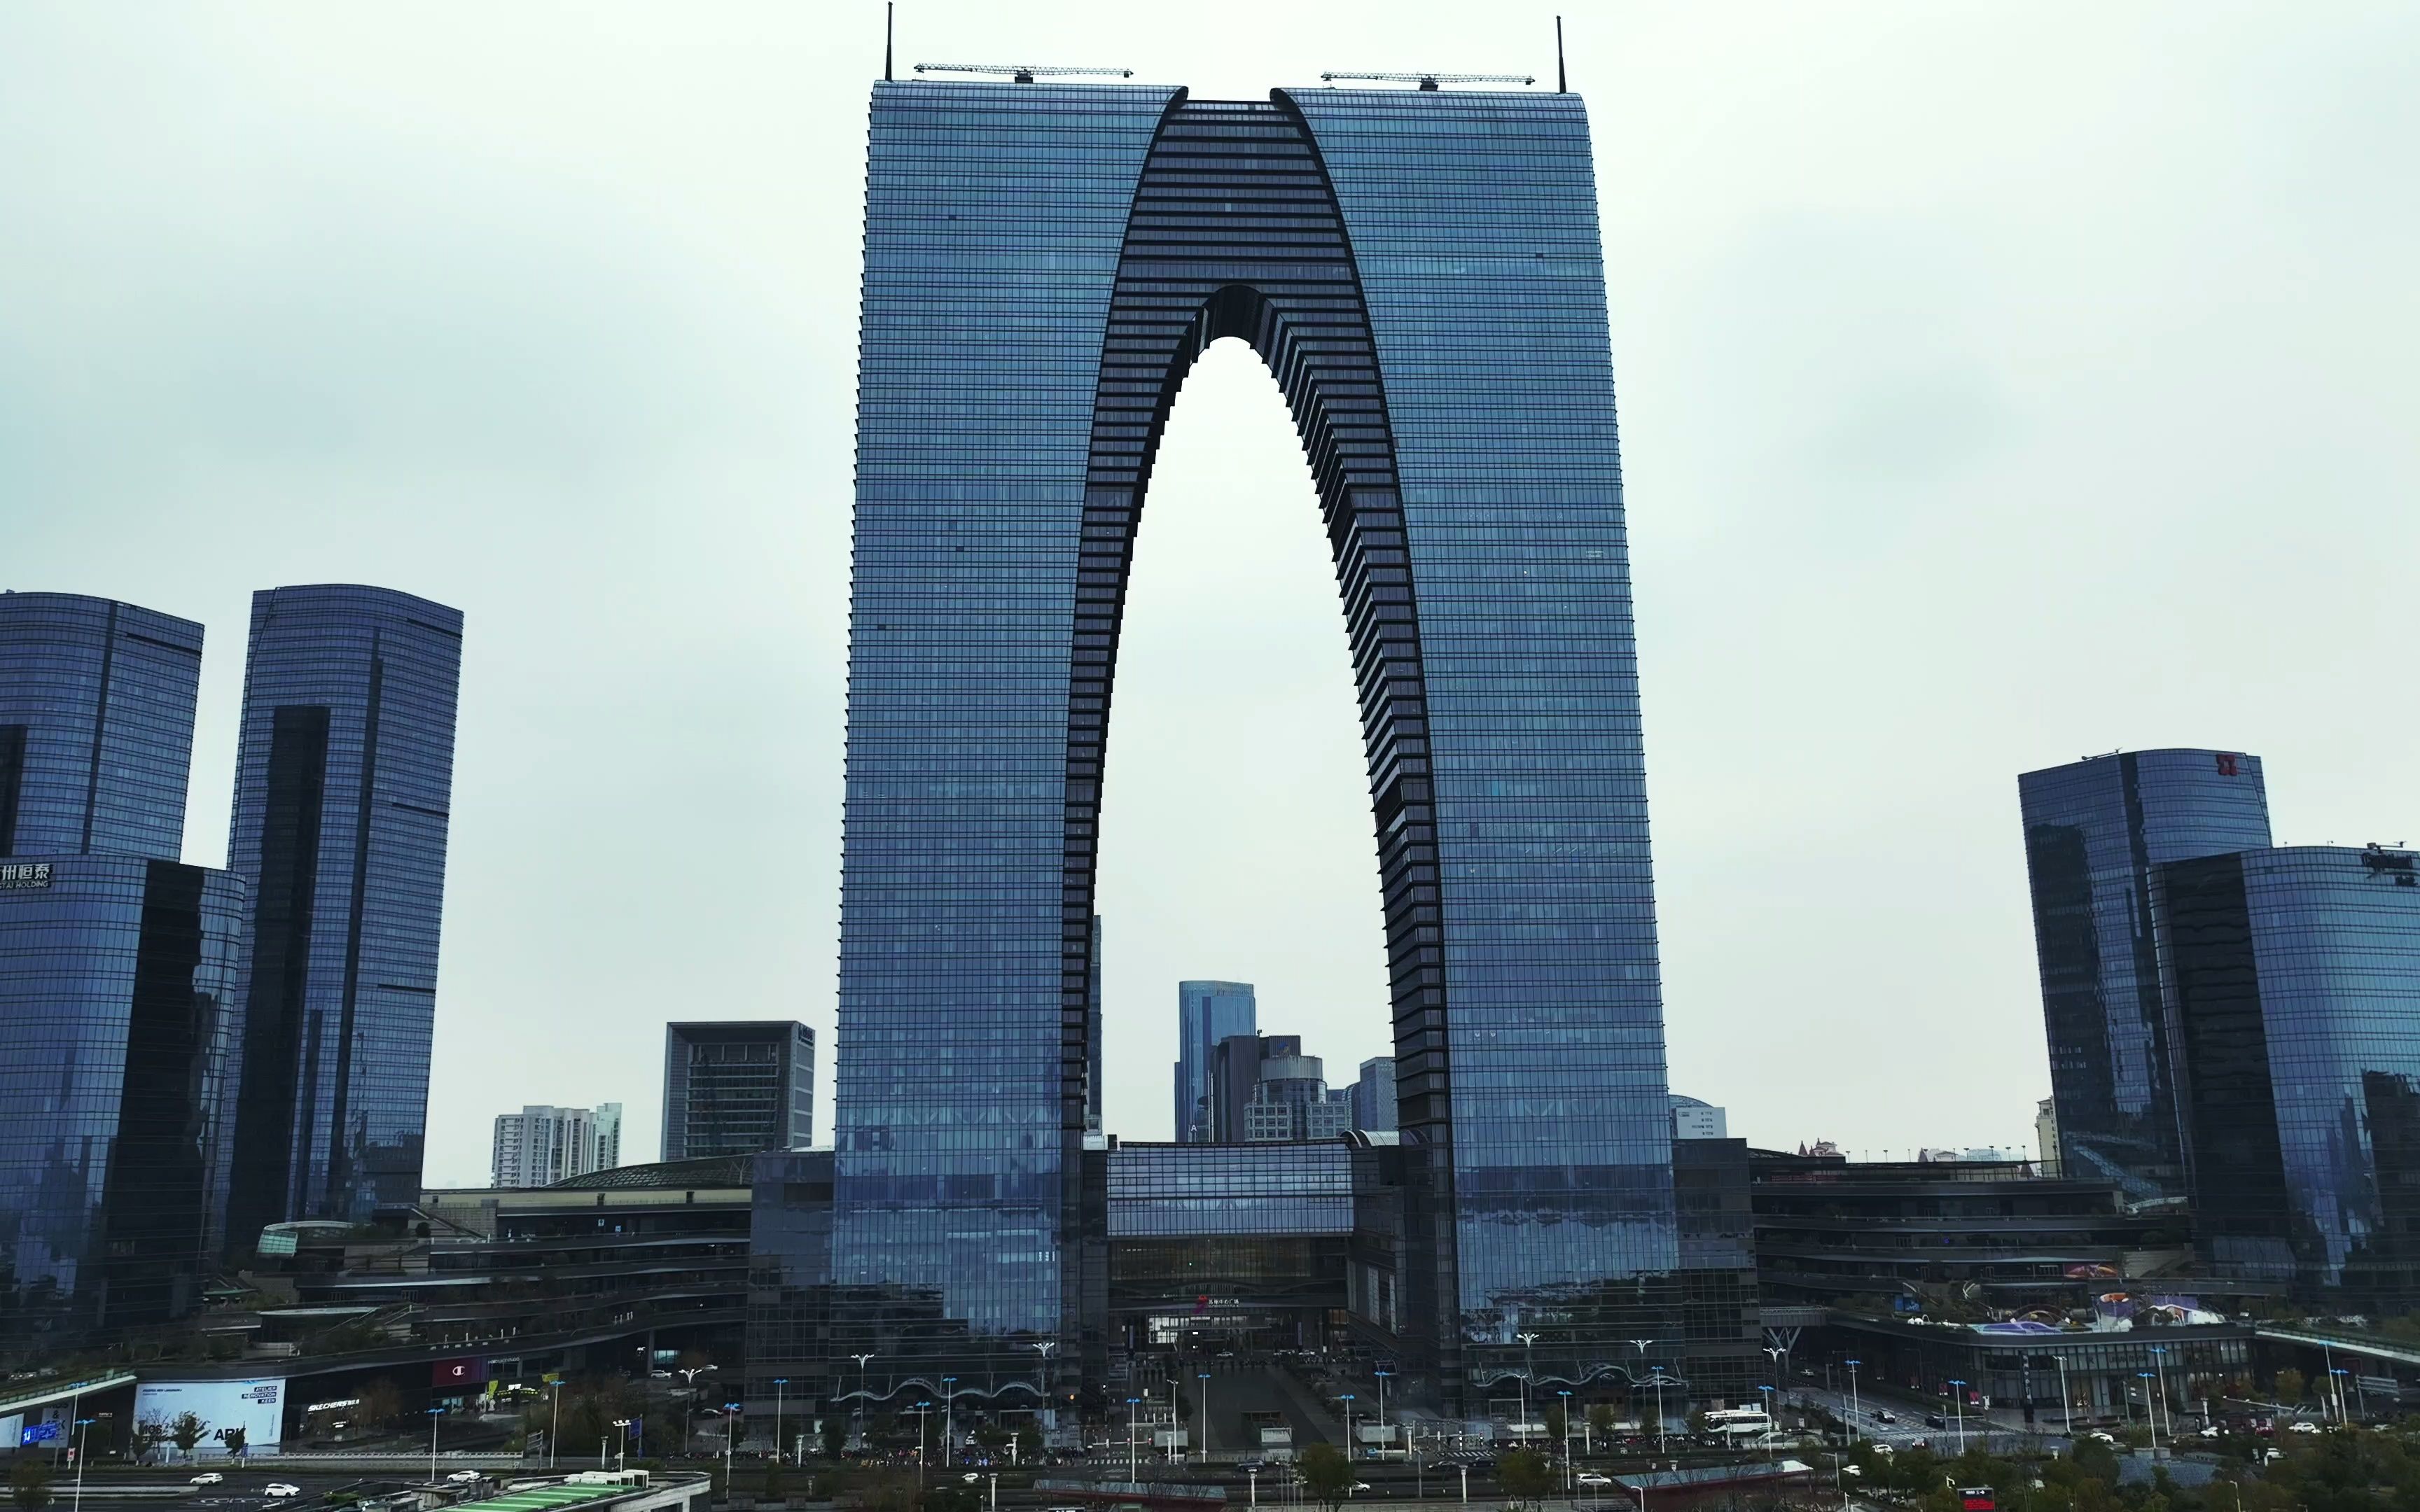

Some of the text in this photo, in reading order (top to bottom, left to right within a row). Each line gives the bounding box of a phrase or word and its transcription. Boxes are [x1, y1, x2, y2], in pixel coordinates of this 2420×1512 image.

[0, 863, 50, 880] 州恒泰
[15, 881, 48, 889] HOLDING
